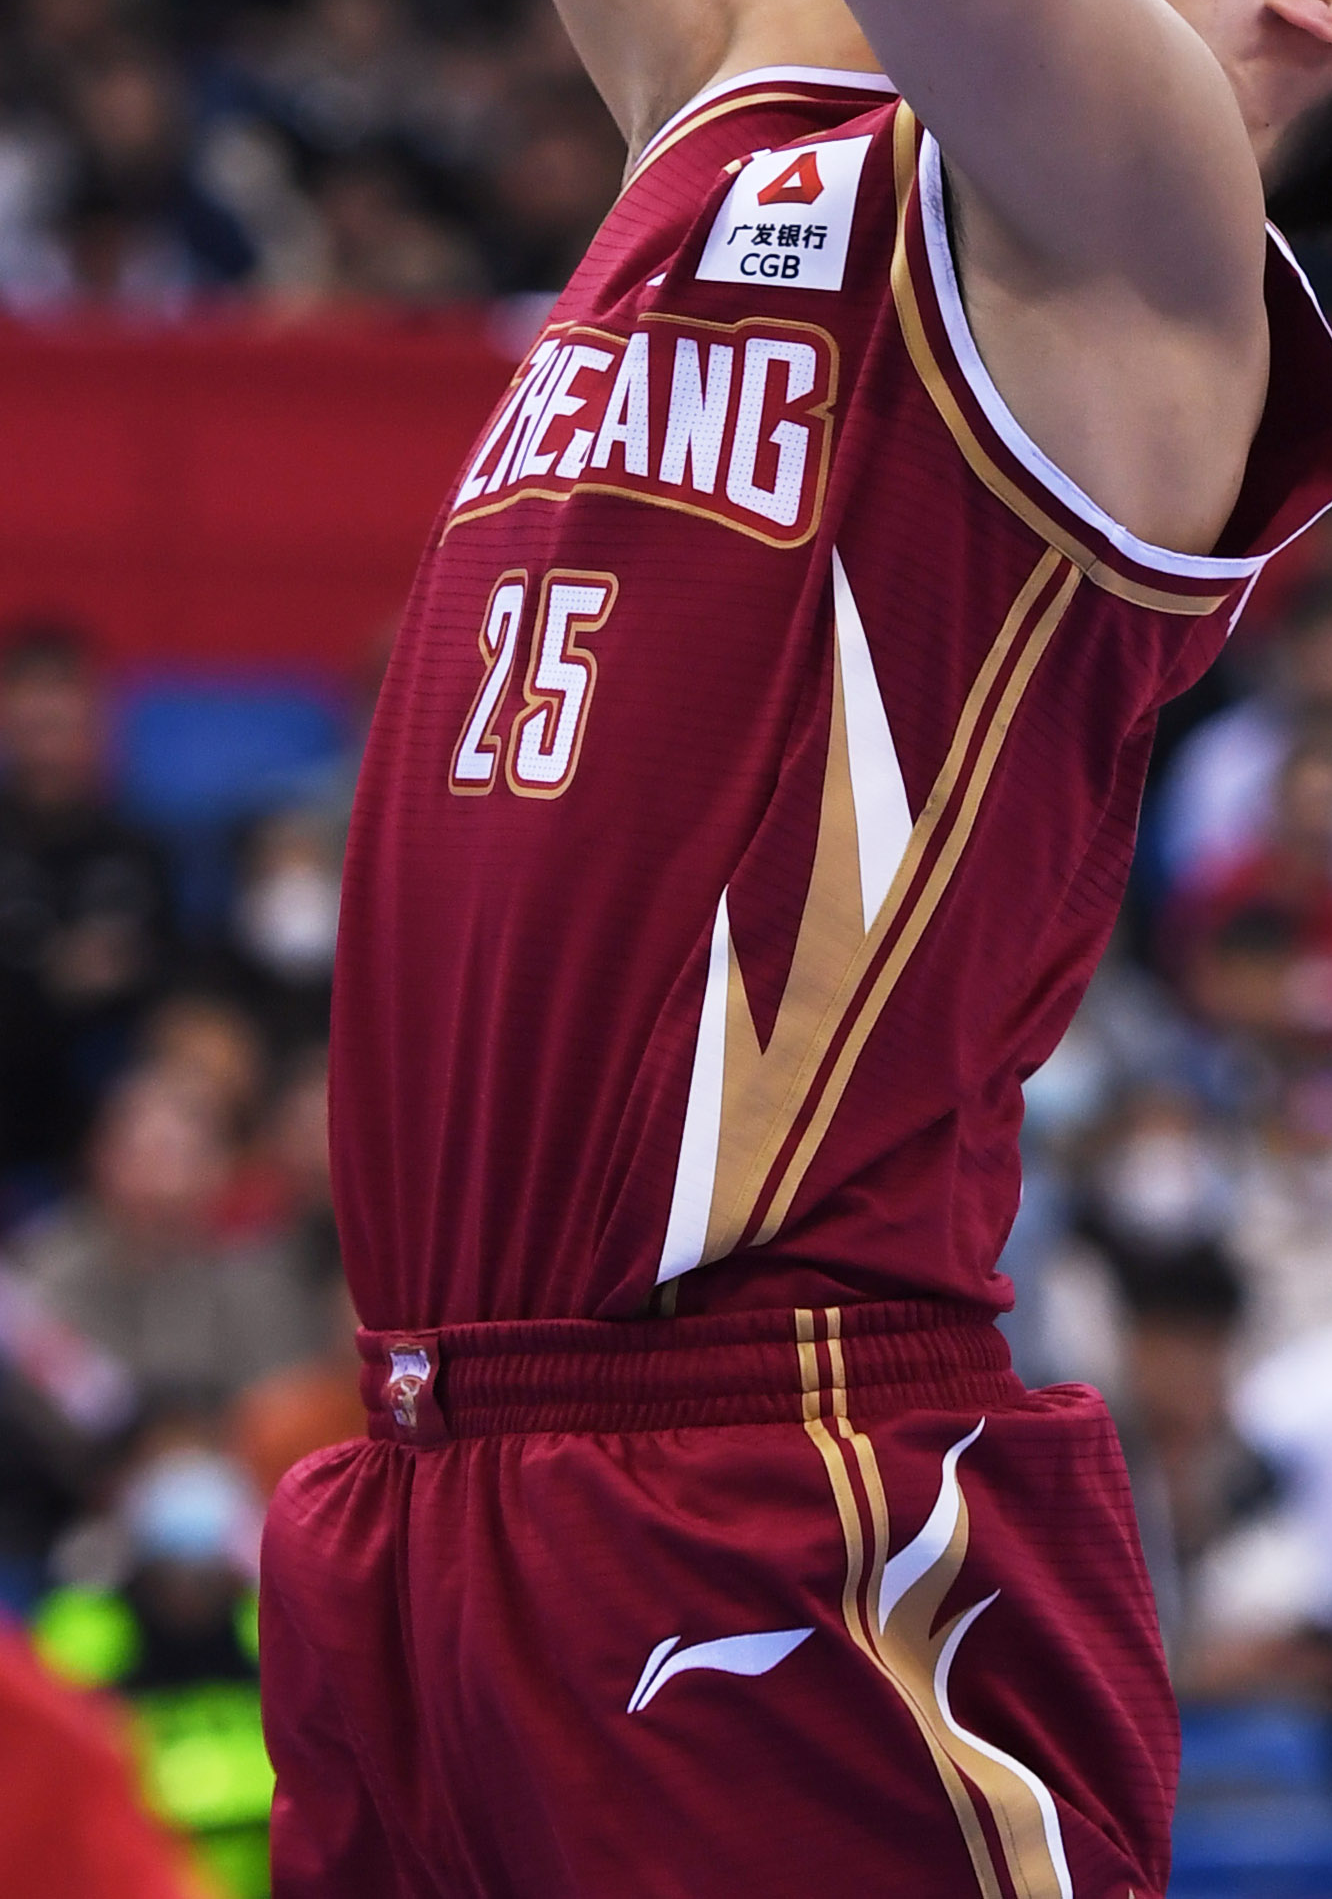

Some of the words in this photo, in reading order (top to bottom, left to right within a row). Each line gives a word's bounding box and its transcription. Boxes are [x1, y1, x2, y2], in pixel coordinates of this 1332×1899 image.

[727, 223, 829, 250] 广发银行
[740, 253, 801, 279] CGB
[453, 583, 608, 783] 25
